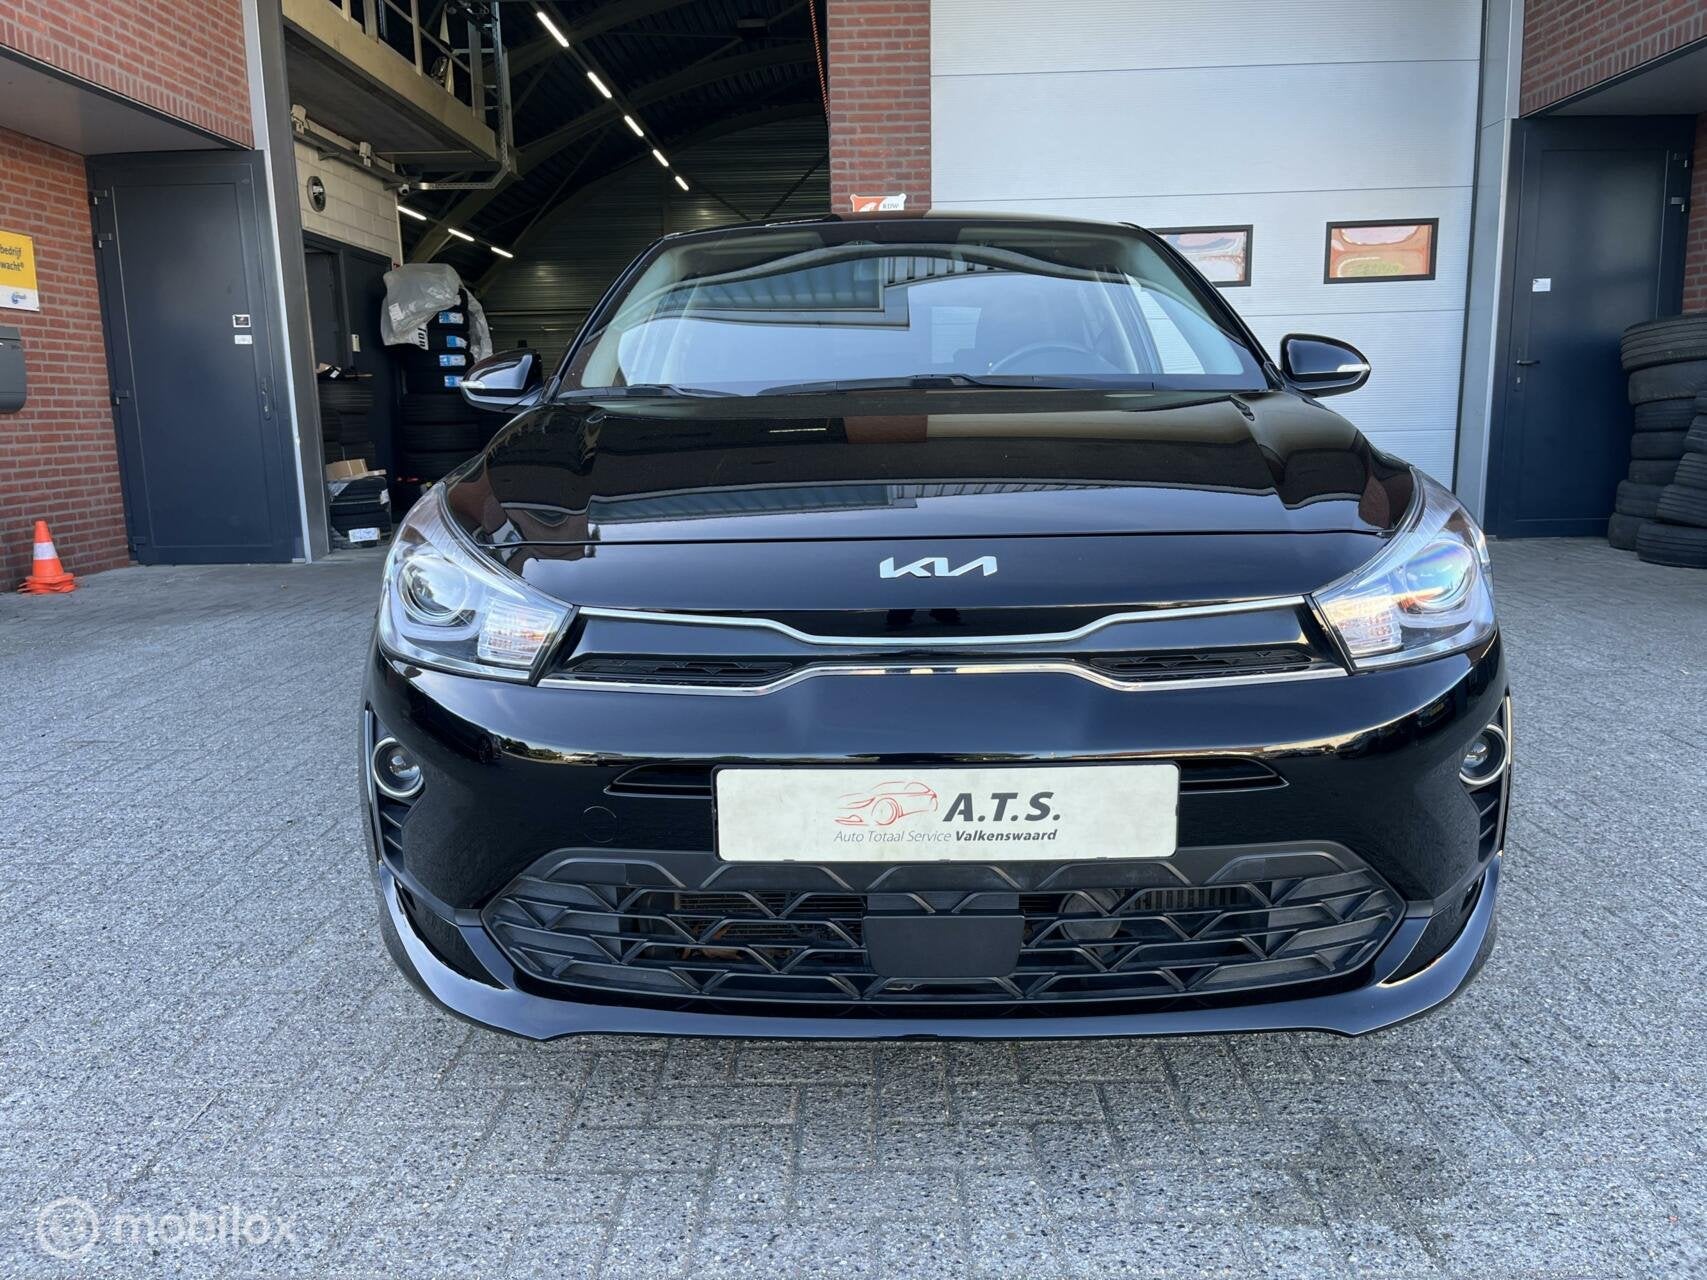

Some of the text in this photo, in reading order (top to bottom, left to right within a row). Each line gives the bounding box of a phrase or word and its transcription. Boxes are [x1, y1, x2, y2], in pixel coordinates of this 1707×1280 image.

[880, 556, 998, 578] KIA
[942, 791, 1061, 822] A.T.S.
[833, 828, 1058, 842] Auto Totaal Service Valkenswaard
